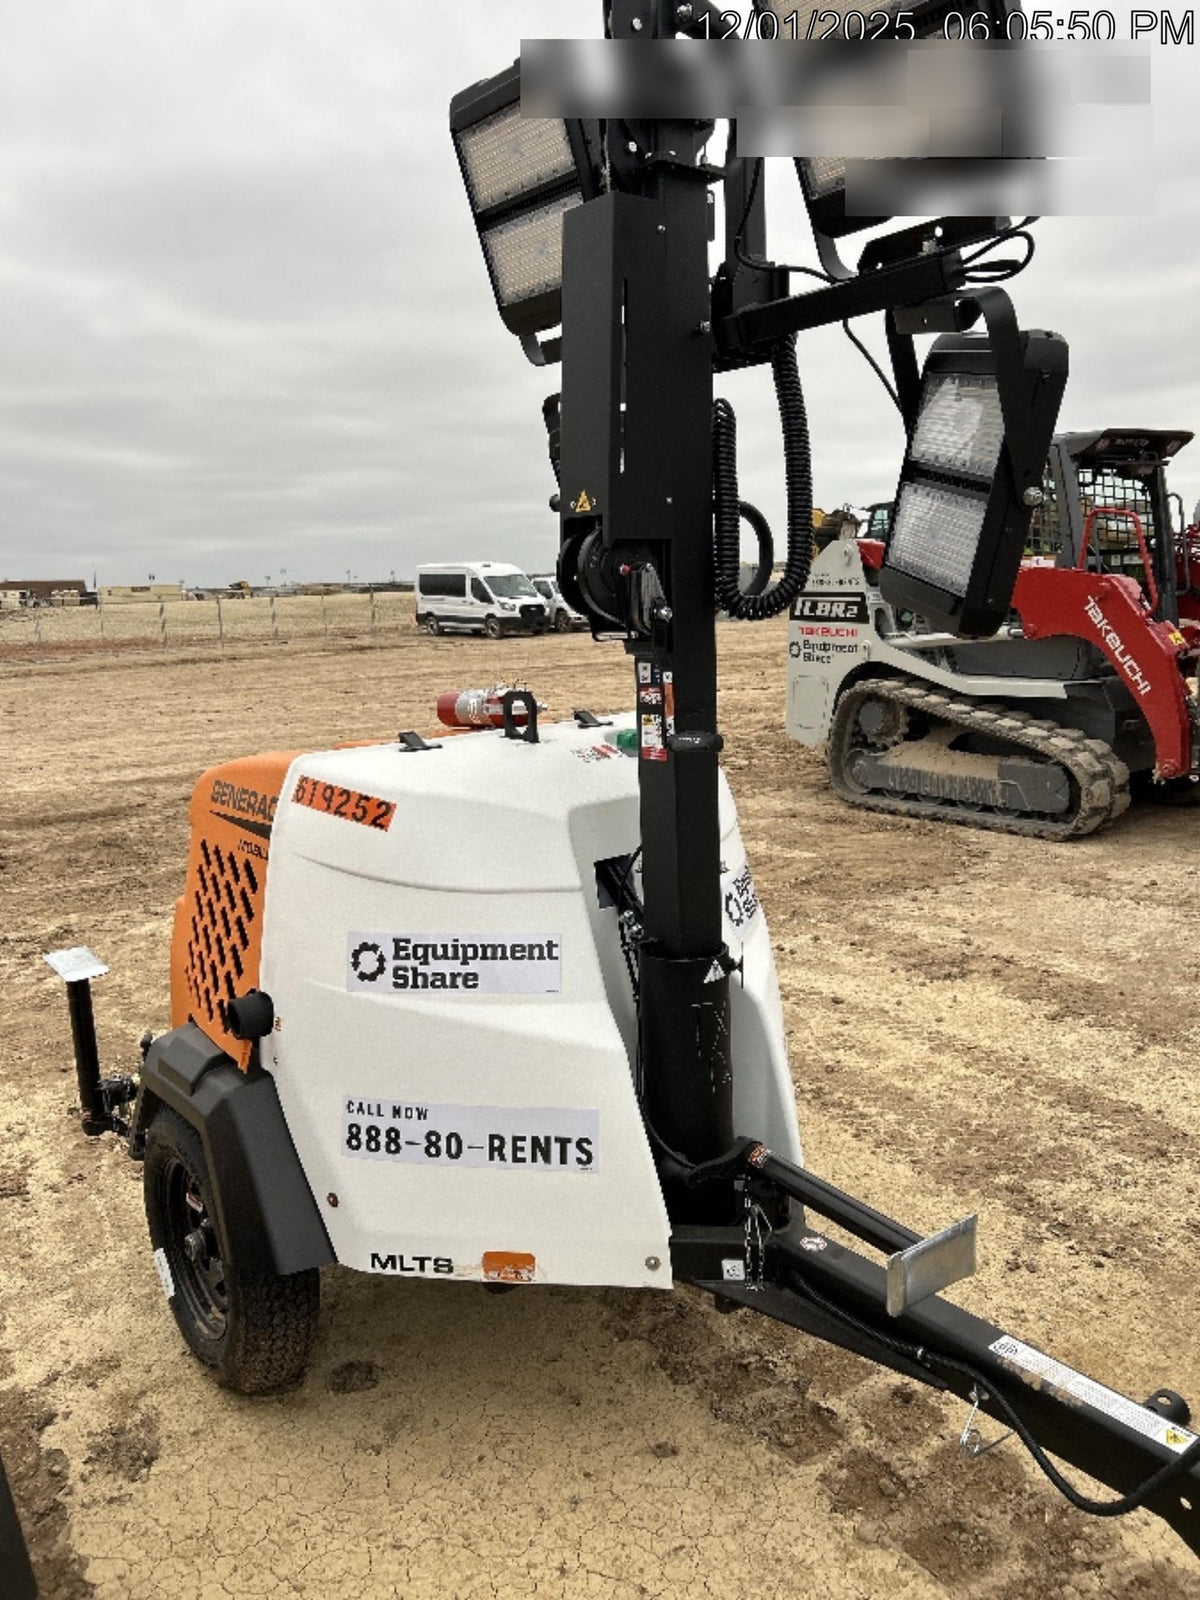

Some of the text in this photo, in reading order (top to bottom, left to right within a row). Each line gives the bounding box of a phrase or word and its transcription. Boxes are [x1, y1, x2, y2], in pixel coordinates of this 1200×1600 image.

[294, 775, 392, 829] 619252
[392, 938, 559, 966] Equipment
[392, 965, 479, 989] Share
[346, 1100, 429, 1121] CALL NOW
[346, 1123, 593, 1166] 888-80-RENTS
